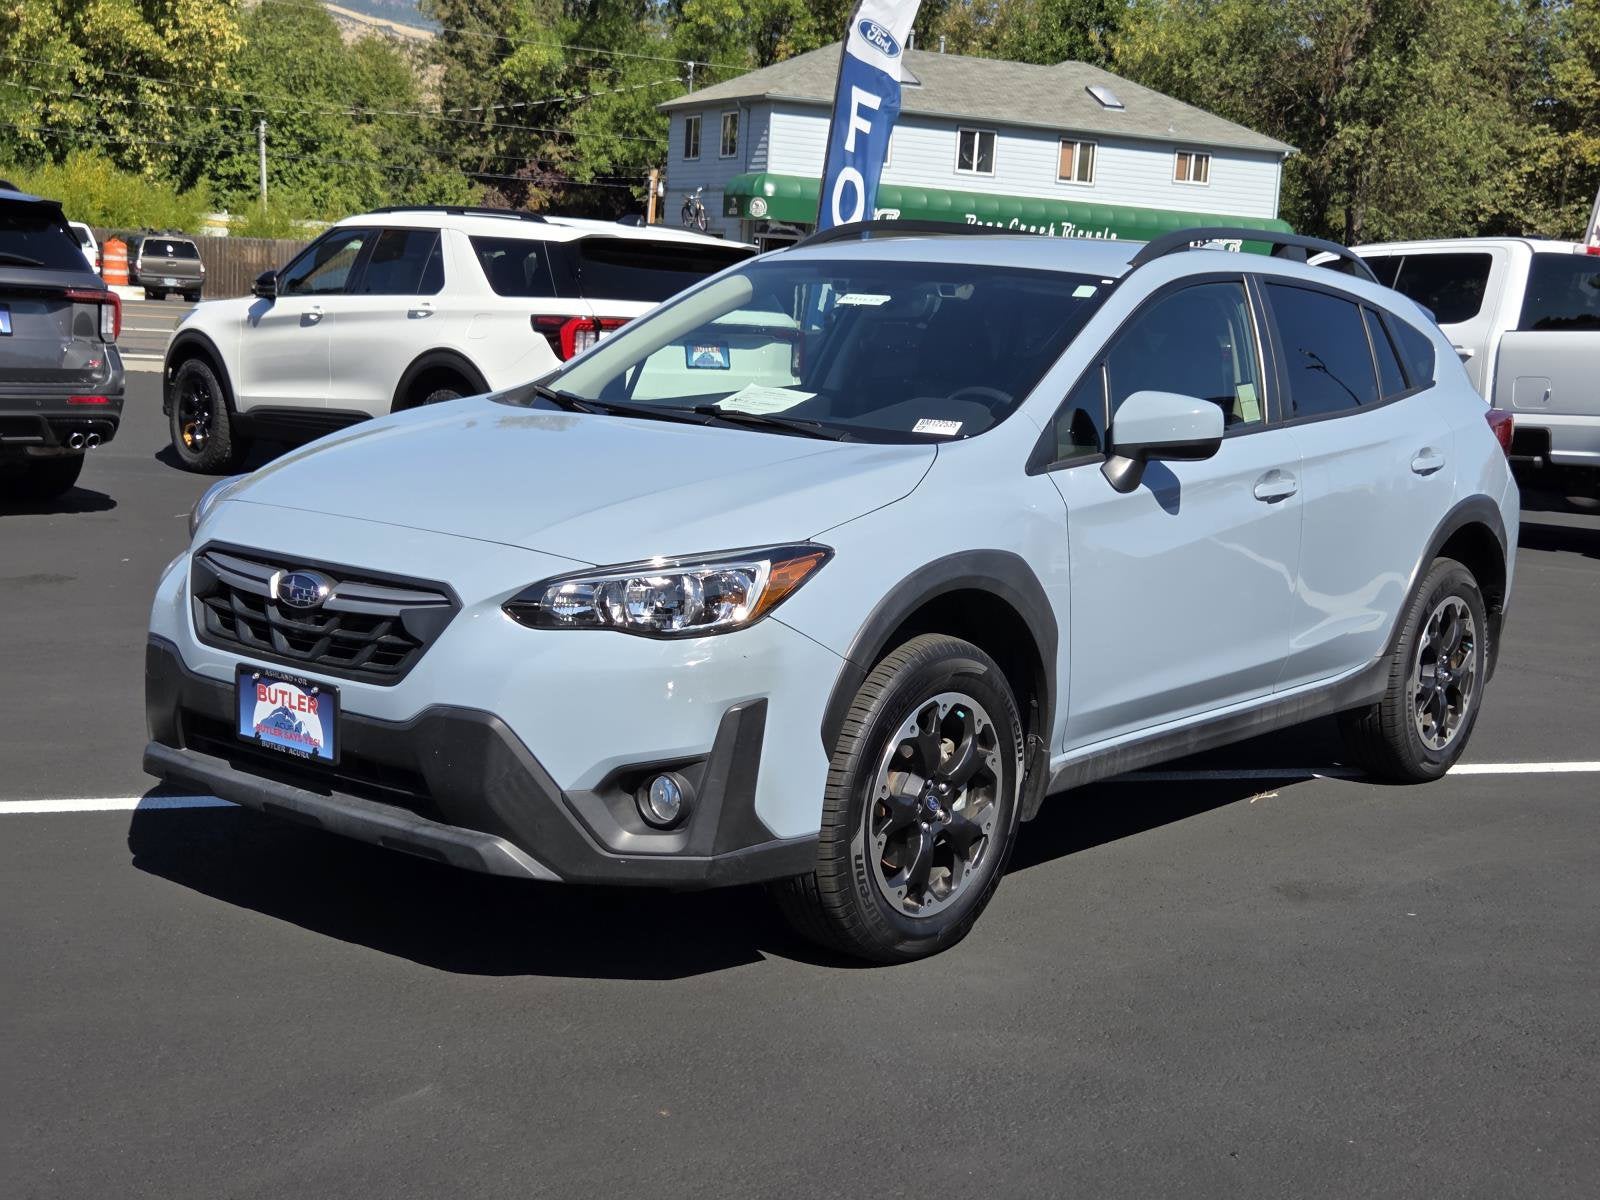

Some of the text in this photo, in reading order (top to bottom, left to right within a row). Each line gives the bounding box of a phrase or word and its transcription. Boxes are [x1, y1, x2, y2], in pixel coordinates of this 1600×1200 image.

[866, 24, 892, 53] Ford
[256, 683, 318, 715] BUTLER
[261, 740, 310, 760] BUTLER ACURA
